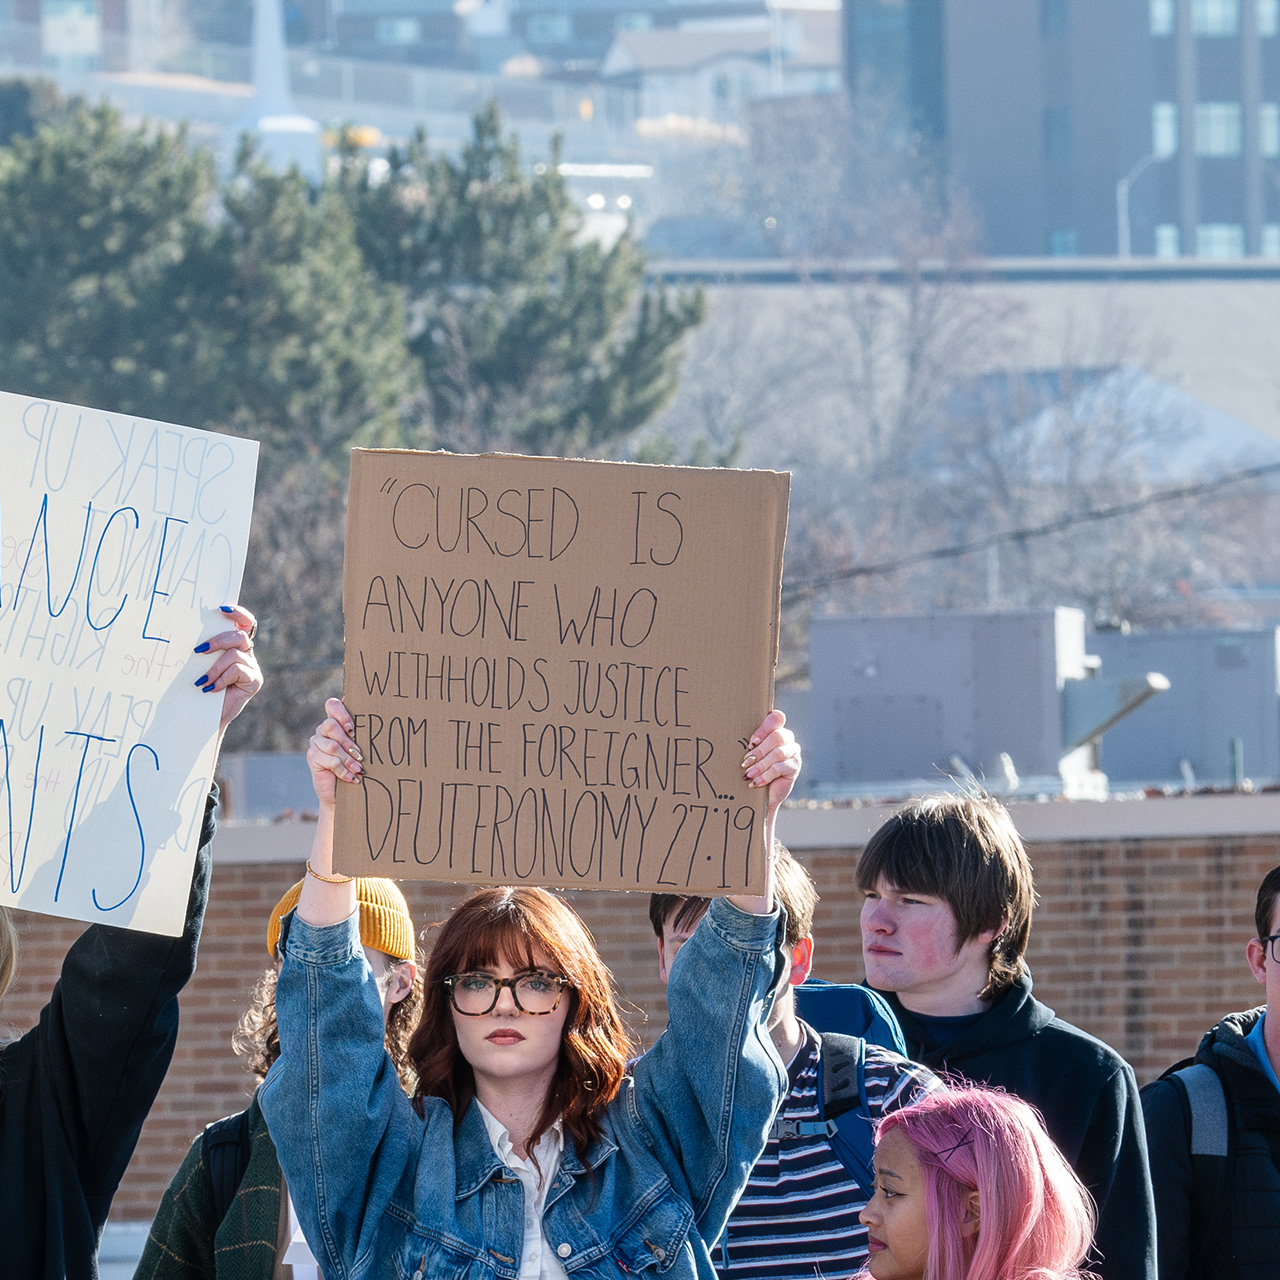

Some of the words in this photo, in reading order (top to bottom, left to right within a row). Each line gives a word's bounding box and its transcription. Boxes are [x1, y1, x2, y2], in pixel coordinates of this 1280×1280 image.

[630, 491, 684, 566] IS
[363, 575, 535, 642] ANYONE
[554, 584, 658, 648] WHO
[360, 650, 550, 712] WITHHOLDS
[564, 659, 692, 728] JUSTICE
[353, 713, 427, 768] FROM
[448, 719, 502, 773] THE
[361, 776, 659, 884] DEUTERONOMY
[658, 804, 756, 888] 27:19
